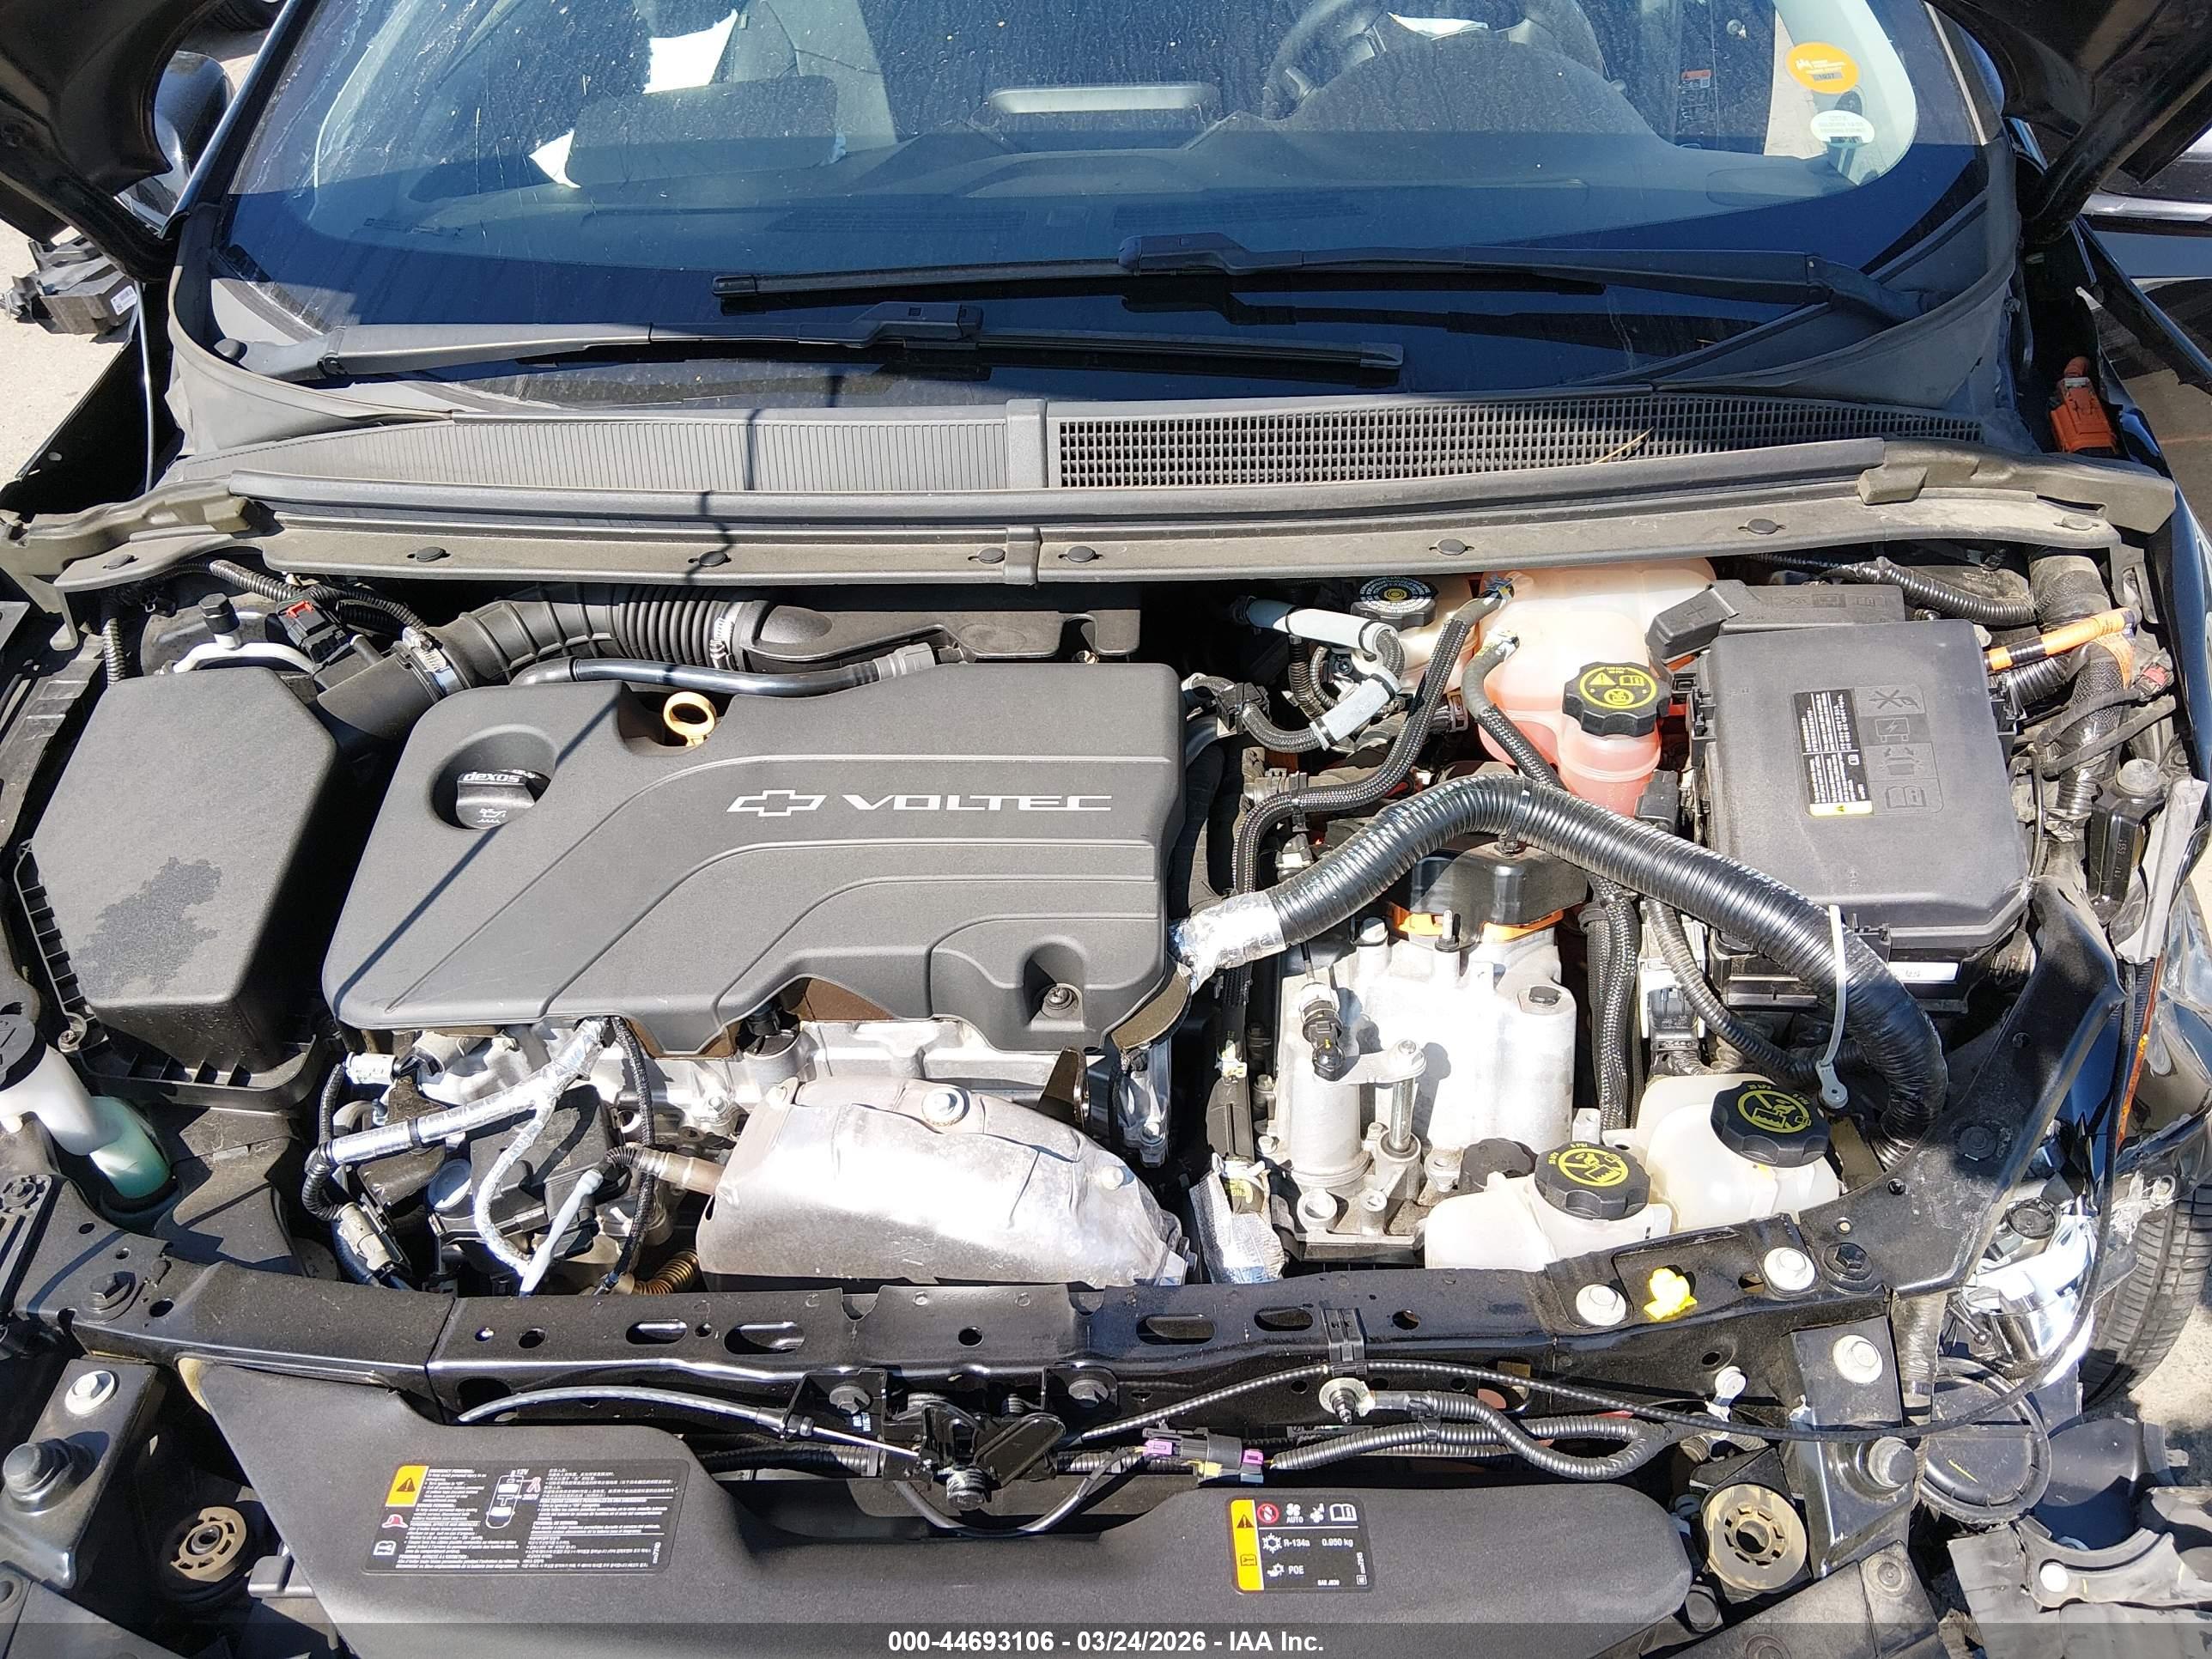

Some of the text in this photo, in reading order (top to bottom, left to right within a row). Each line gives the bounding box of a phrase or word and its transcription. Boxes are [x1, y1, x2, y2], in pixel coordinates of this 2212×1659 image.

[463, 771, 522, 783] dexos
[842, 794, 1112, 811] VOLTEC
[1284, 1538, 1310, 1547] R-134a
[1343, 1538, 1353, 1547] kg
[1288, 1565, 1304, 1574] POE
